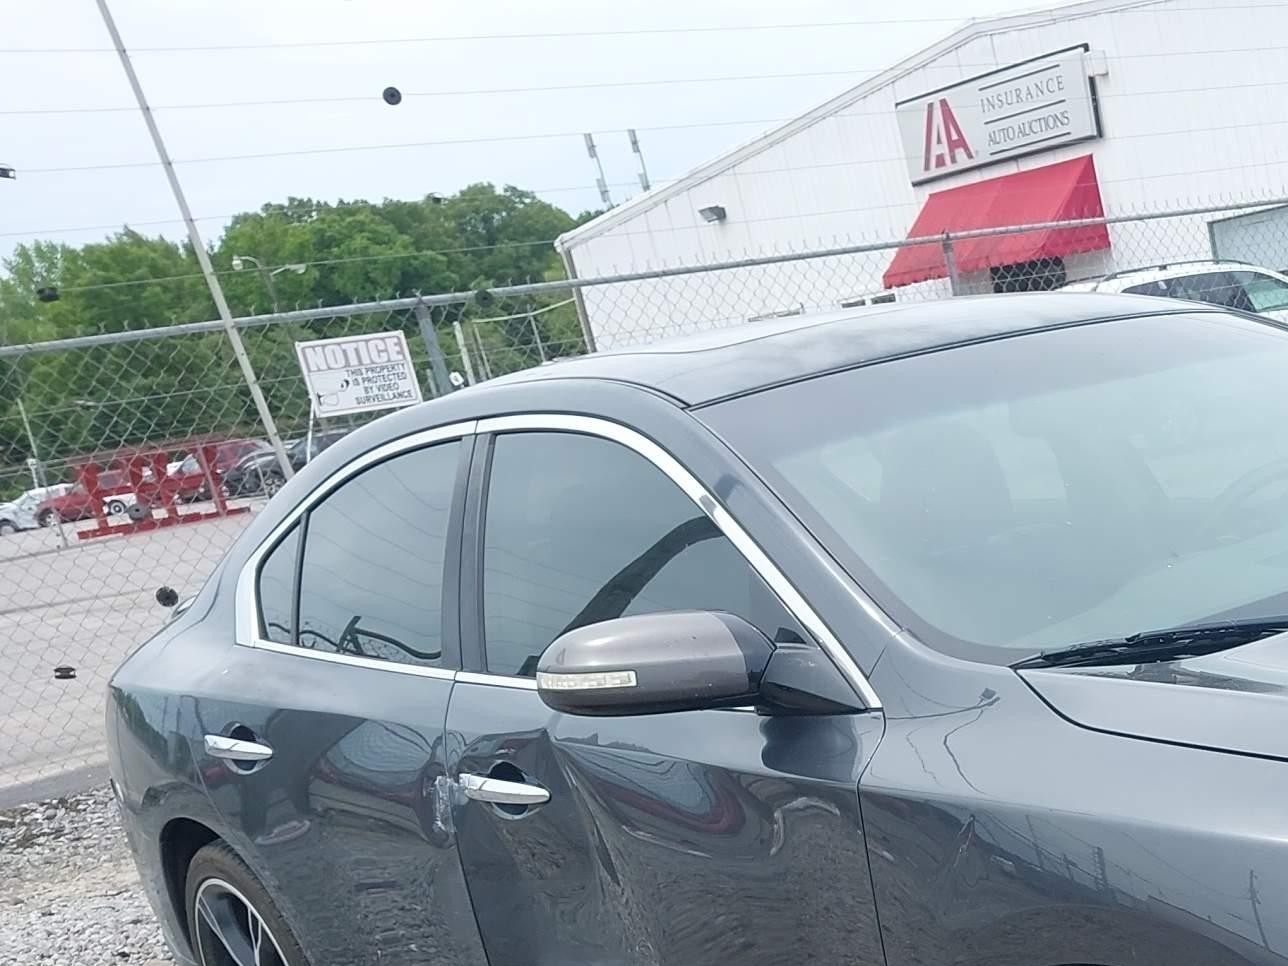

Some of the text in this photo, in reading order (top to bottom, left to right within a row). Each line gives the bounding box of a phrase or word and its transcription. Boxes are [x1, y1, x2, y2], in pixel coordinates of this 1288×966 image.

[980, 75, 1065, 113] INSURANCE
[987, 110, 1070, 147] AUTO AUCTIONS
[303, 337, 404, 372] NOTICE
[346, 363, 405, 378] THIS PROPERTY
[352, 372, 407, 386] IS PROTECTED
[363, 382, 400, 395] BY VIDEO
[355, 389, 413, 405] SURVEILLANCE
